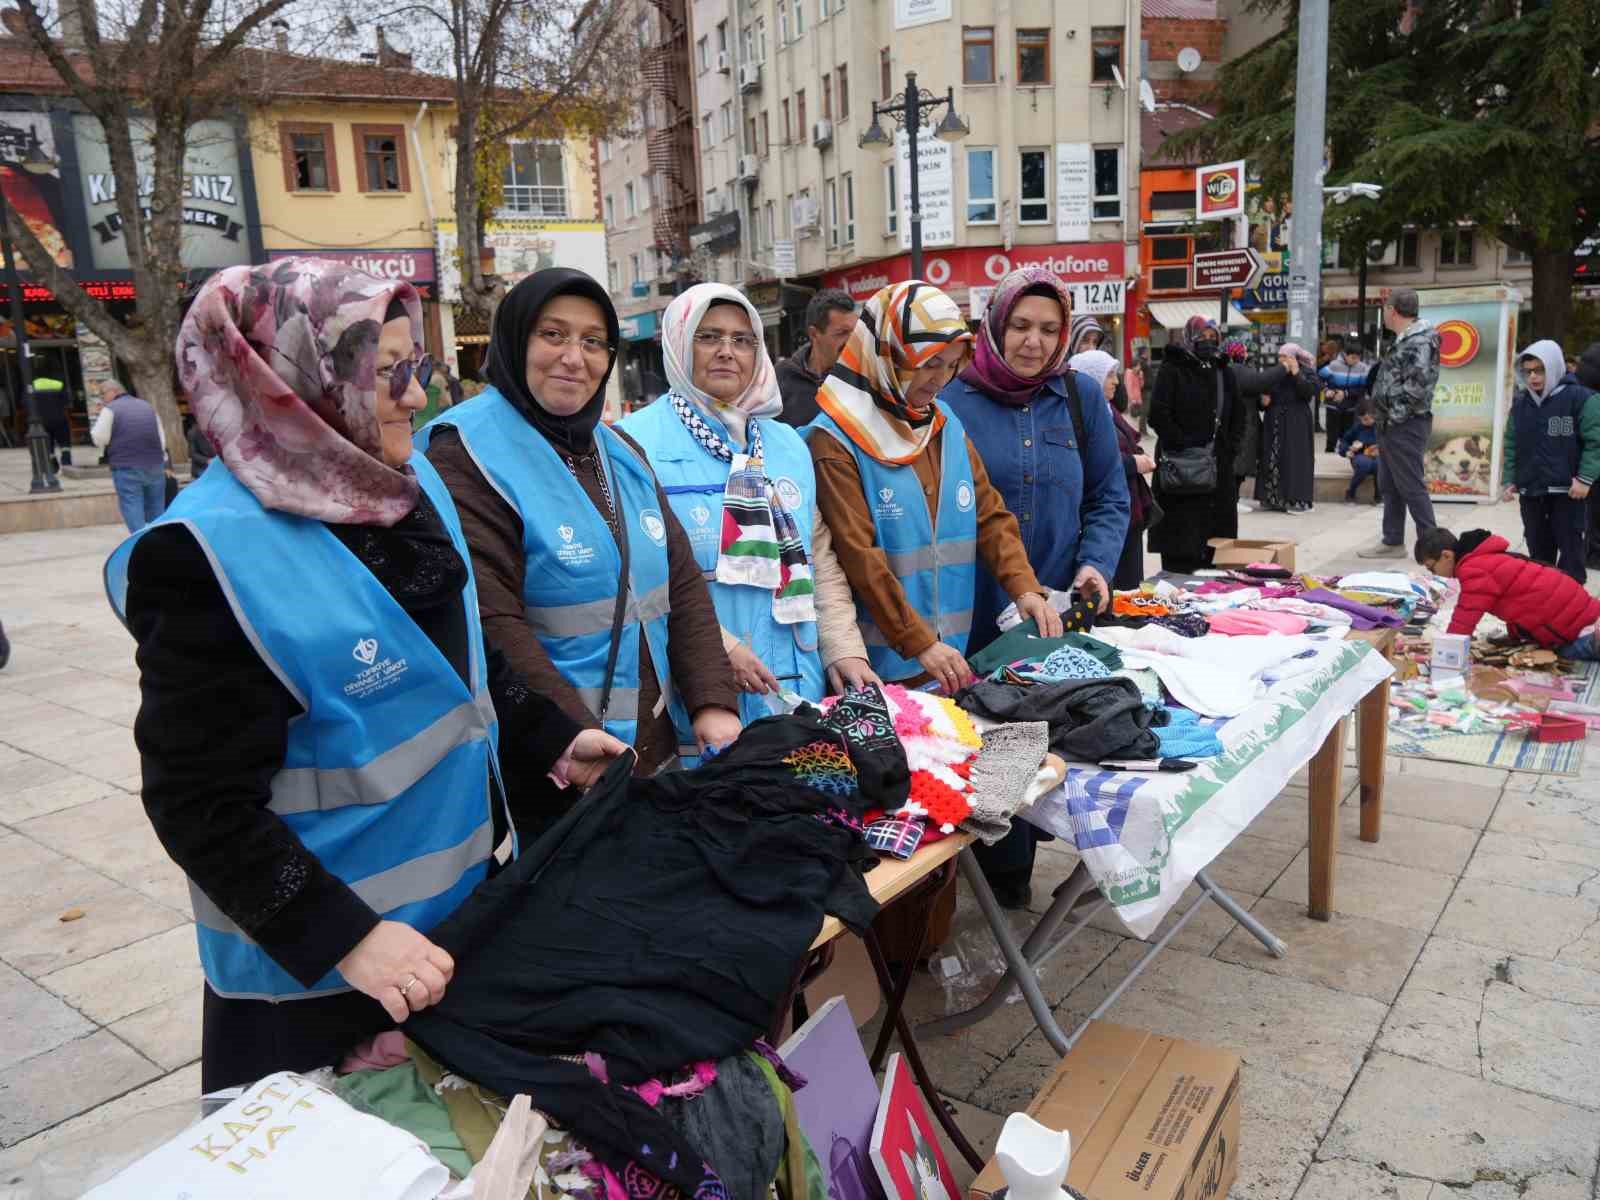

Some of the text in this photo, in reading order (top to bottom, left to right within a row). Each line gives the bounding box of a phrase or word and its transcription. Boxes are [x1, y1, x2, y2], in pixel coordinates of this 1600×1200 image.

[1084, 282, 1121, 303] 12 AY
[1125, 1152, 1151, 1182] ÜLKER
